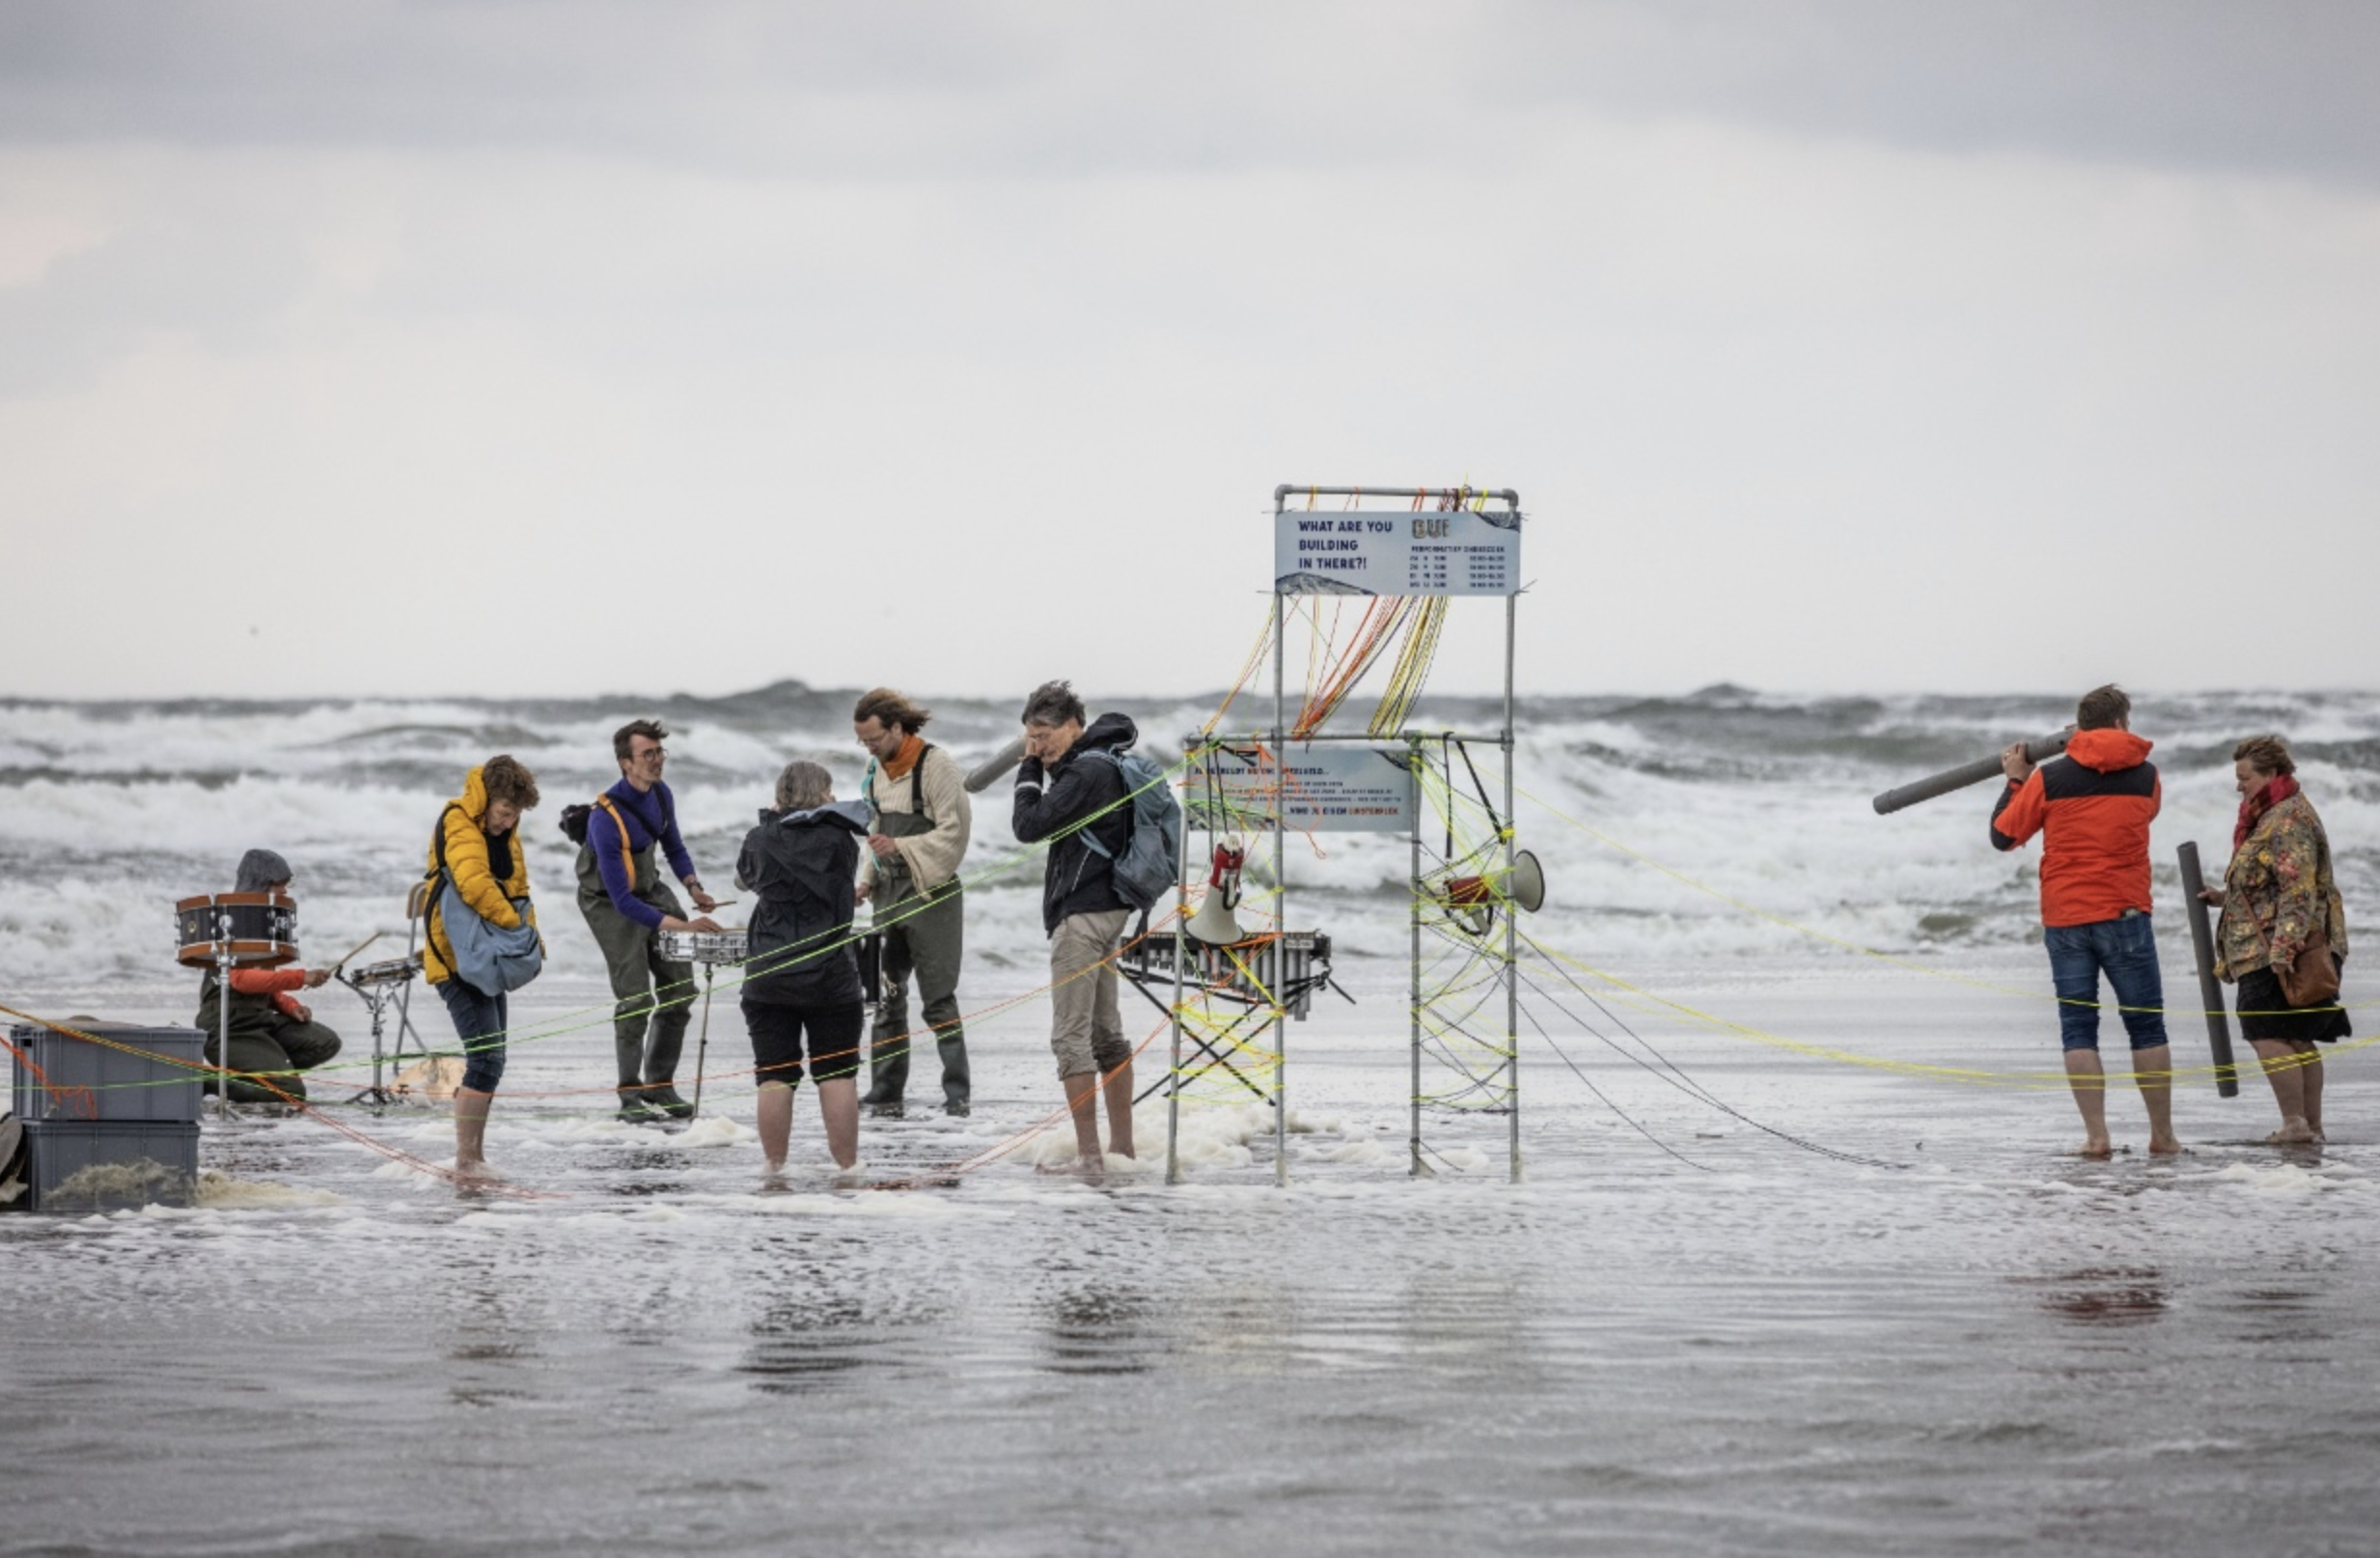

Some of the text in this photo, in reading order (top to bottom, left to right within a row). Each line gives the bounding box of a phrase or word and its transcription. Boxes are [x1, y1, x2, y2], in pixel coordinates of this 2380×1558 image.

[1298, 520, 1394, 533] WHAT ARE YOU
[1299, 540, 1359, 551] BUILDING
[1299, 557, 1367, 570] IN THERE?!
